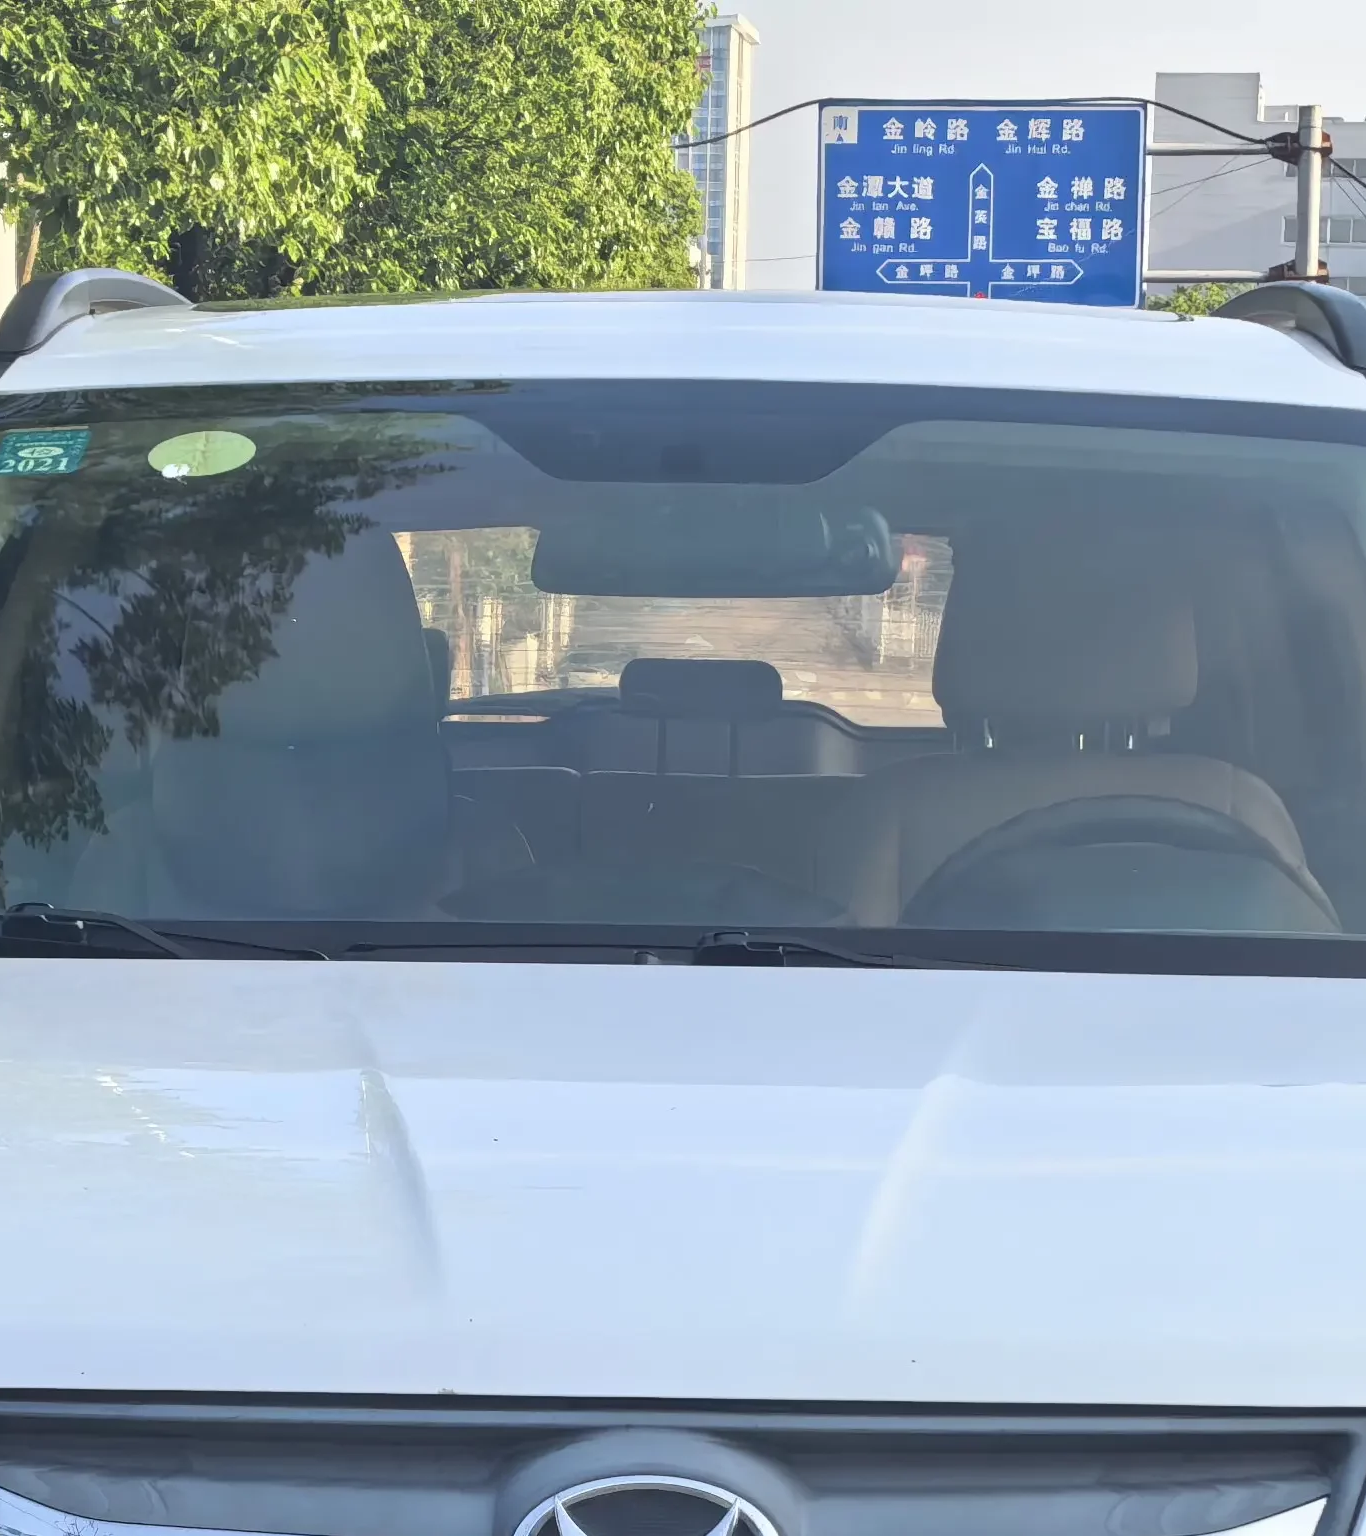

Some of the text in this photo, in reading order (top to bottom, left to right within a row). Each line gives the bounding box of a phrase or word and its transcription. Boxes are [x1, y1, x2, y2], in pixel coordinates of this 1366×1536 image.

[882, 117, 970, 141] 金岭路
[996, 118, 1085, 142] 金辉路
[891, 143, 908, 154] Jin
[1005, 143, 1022, 154] Jin
[1051, 143, 1071, 155] Rd.
[837, 174, 935, 200] 金潭大道
[1036, 175, 1127, 201] 金禅路
[849, 201, 865, 212] Jin
[1043, 201, 1113, 212] Jin chan Rd.
[1036, 217, 1124, 241] 宝福路
[850, 242, 867, 252] Jin
[1047, 242, 1069, 253] Bao
[1090, 242, 1109, 254] Rd.
